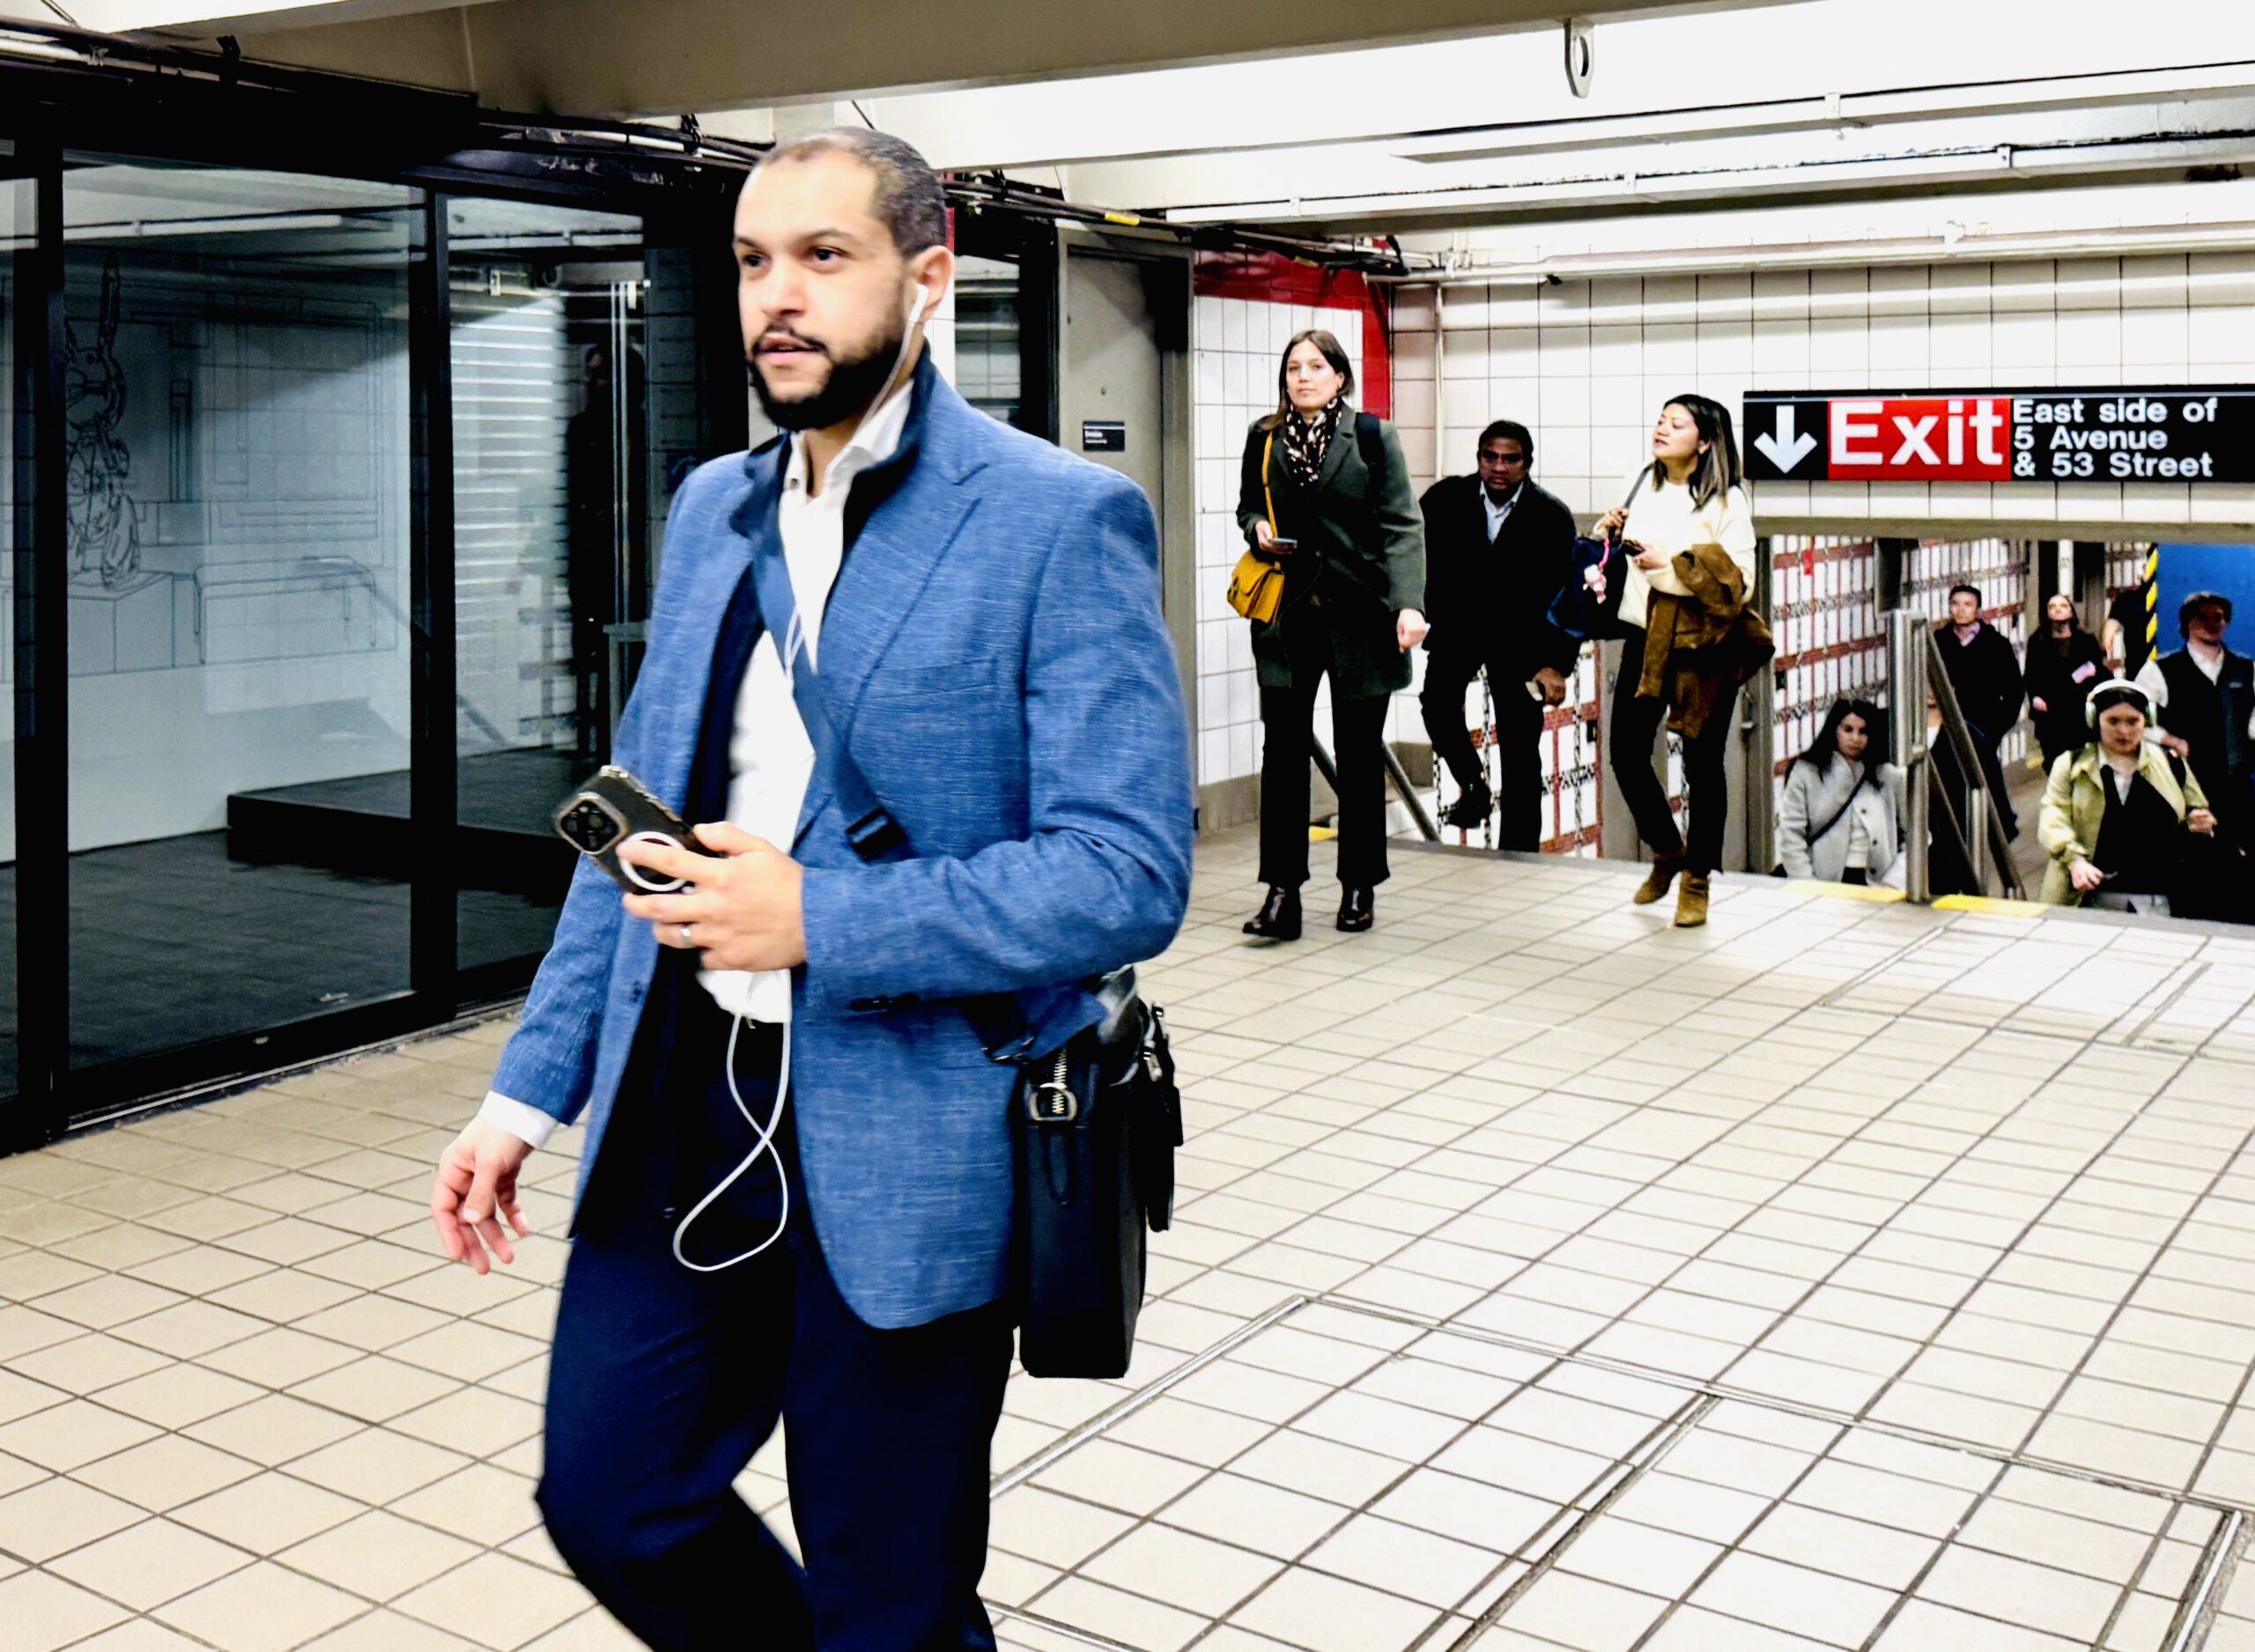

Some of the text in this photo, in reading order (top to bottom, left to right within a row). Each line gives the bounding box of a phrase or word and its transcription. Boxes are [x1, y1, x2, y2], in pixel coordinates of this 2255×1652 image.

[2013, 396, 2219, 424] East side of
[1830, 400, 2003, 465] Exit
[2014, 425, 2169, 450] 5 Avenue
[2014, 451, 2214, 477] & 53 Street
